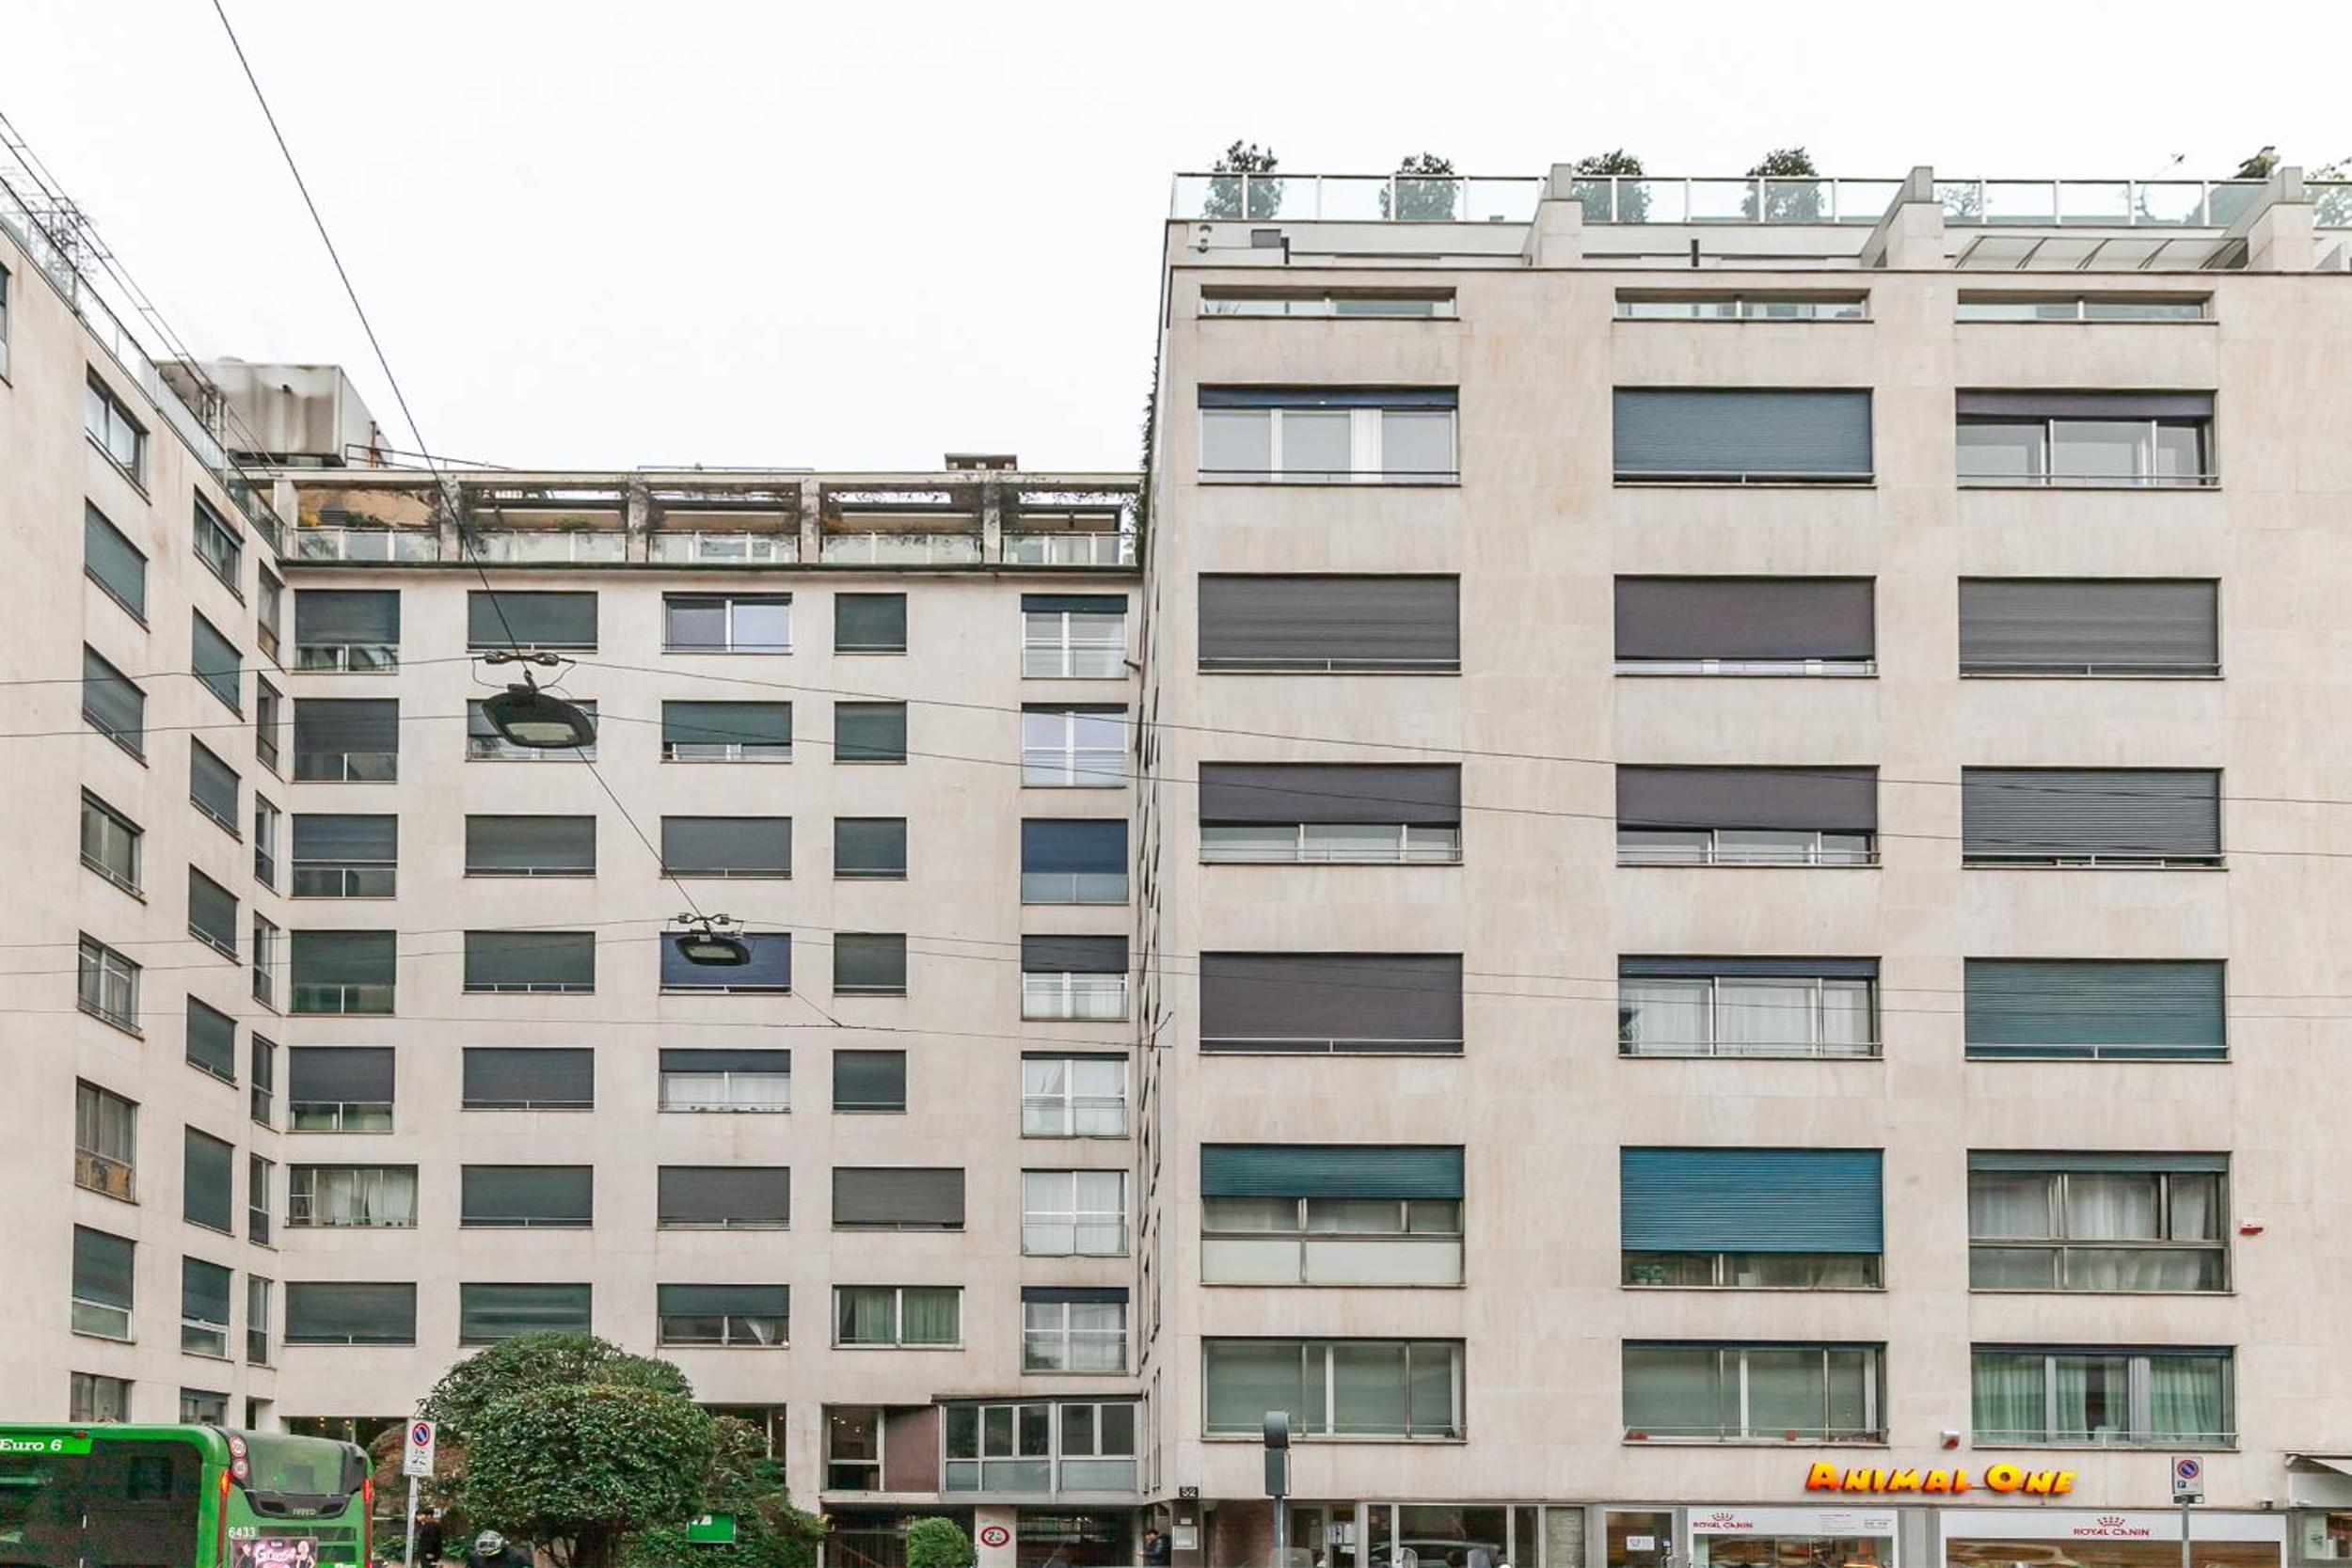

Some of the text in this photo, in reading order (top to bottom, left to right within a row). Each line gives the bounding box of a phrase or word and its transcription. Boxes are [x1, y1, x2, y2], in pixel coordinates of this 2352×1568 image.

[0, 1439, 63, 1451] Euro 6
[1805, 1462, 2077, 1495] ANIMAL ONE
[1692, 1521, 1722, 1529] ROYAL
[228, 1526, 256, 1538] 6433
